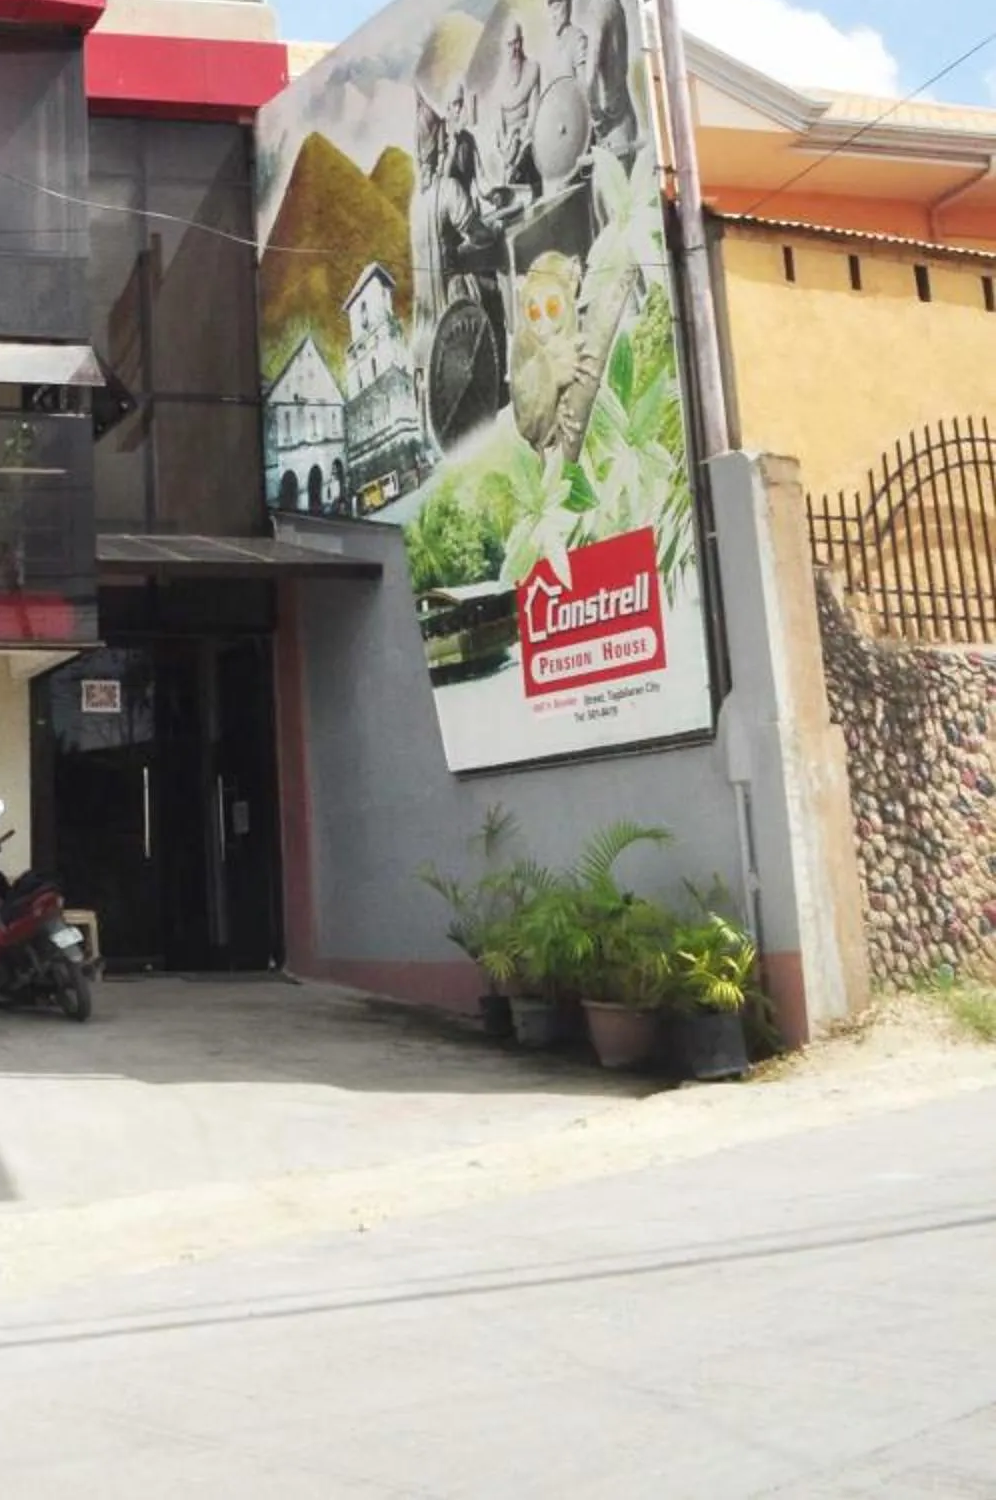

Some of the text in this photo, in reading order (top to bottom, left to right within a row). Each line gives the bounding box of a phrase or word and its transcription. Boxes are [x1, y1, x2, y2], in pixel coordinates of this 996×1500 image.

[546, 572, 649, 635] Constrell
[539, 637, 647, 676] PENSION HOUSE
